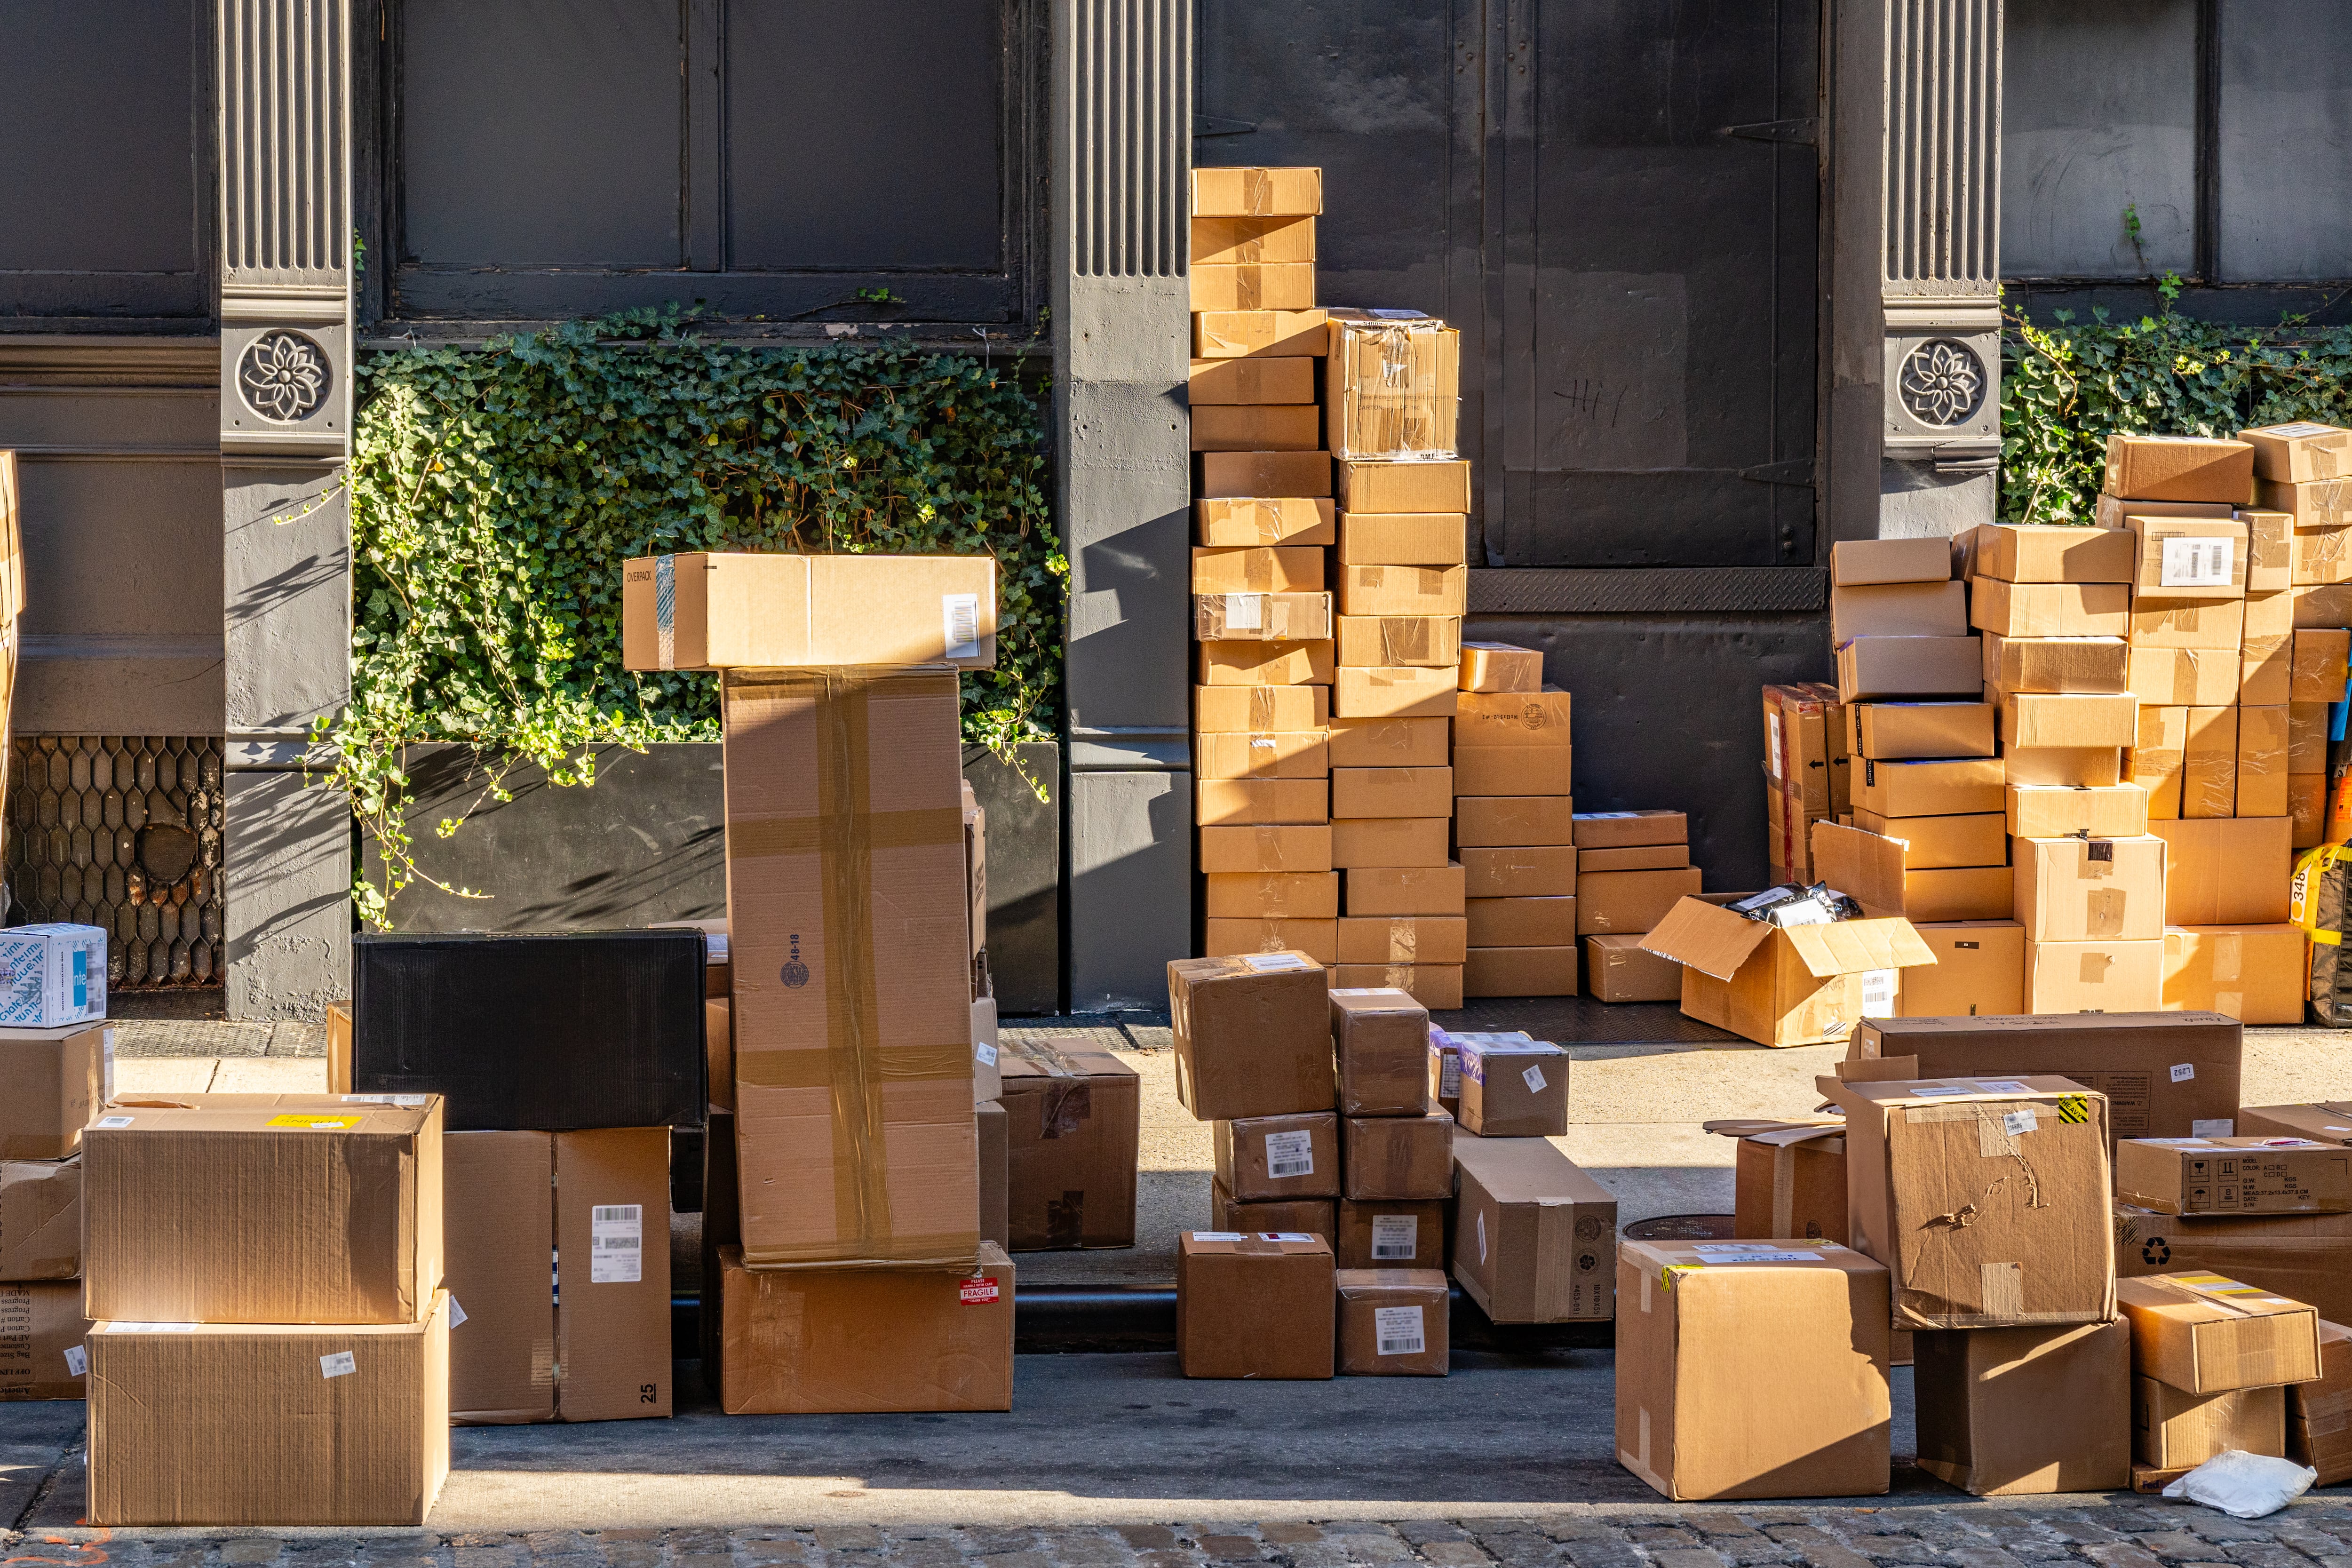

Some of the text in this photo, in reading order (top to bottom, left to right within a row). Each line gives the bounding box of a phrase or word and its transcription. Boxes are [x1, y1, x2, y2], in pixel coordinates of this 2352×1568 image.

[627, 570, 652, 583] OVERPACK
[2294, 873, 2305, 901] 348
[790, 934, 800, 961] 48-18
[2061, 1099, 2082, 1118] HEAVY
[963, 1288, 993, 1297] FRAGILE
[640, 1383, 654, 1404] 25
